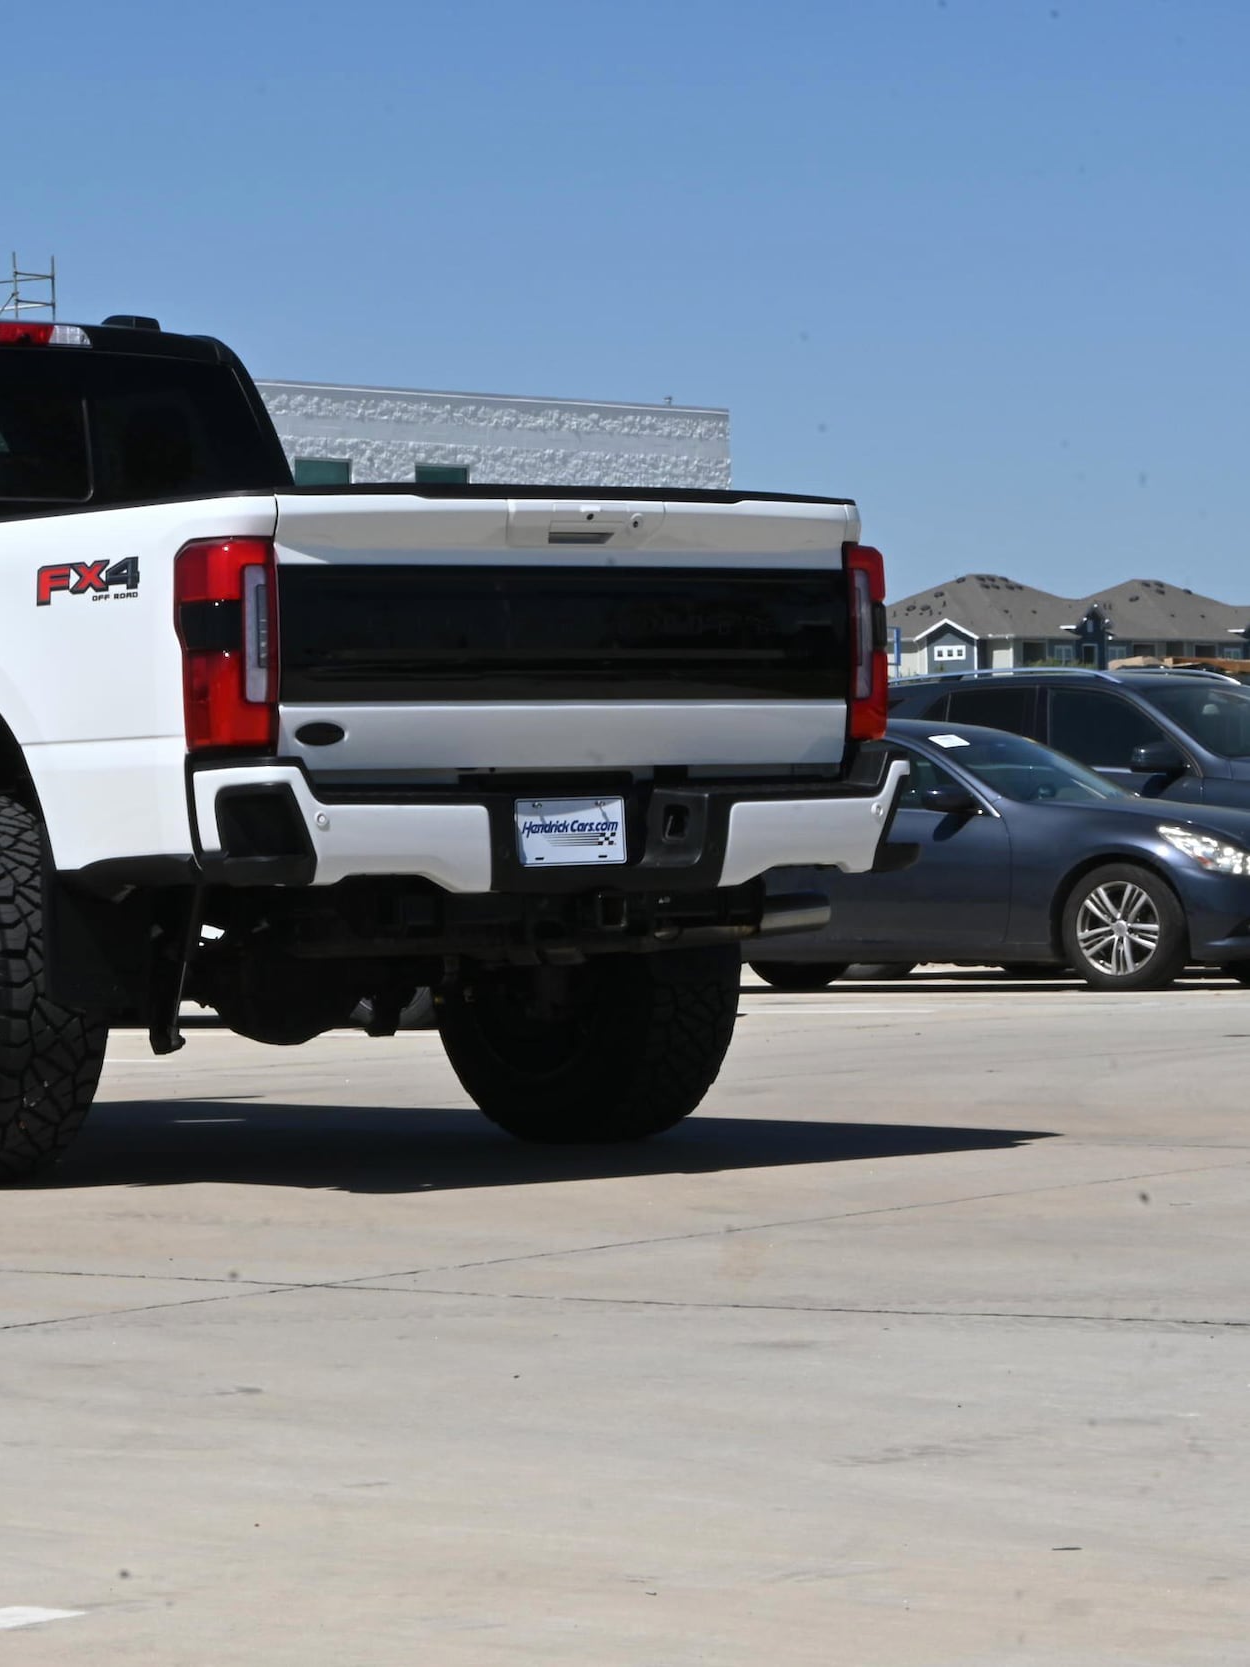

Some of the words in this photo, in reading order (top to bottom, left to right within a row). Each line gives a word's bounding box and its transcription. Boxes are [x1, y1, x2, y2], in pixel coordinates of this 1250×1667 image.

[36, 556, 140, 607] FX4
[92, 594, 111, 602] OFF
[114, 591, 139, 600] ROAD
